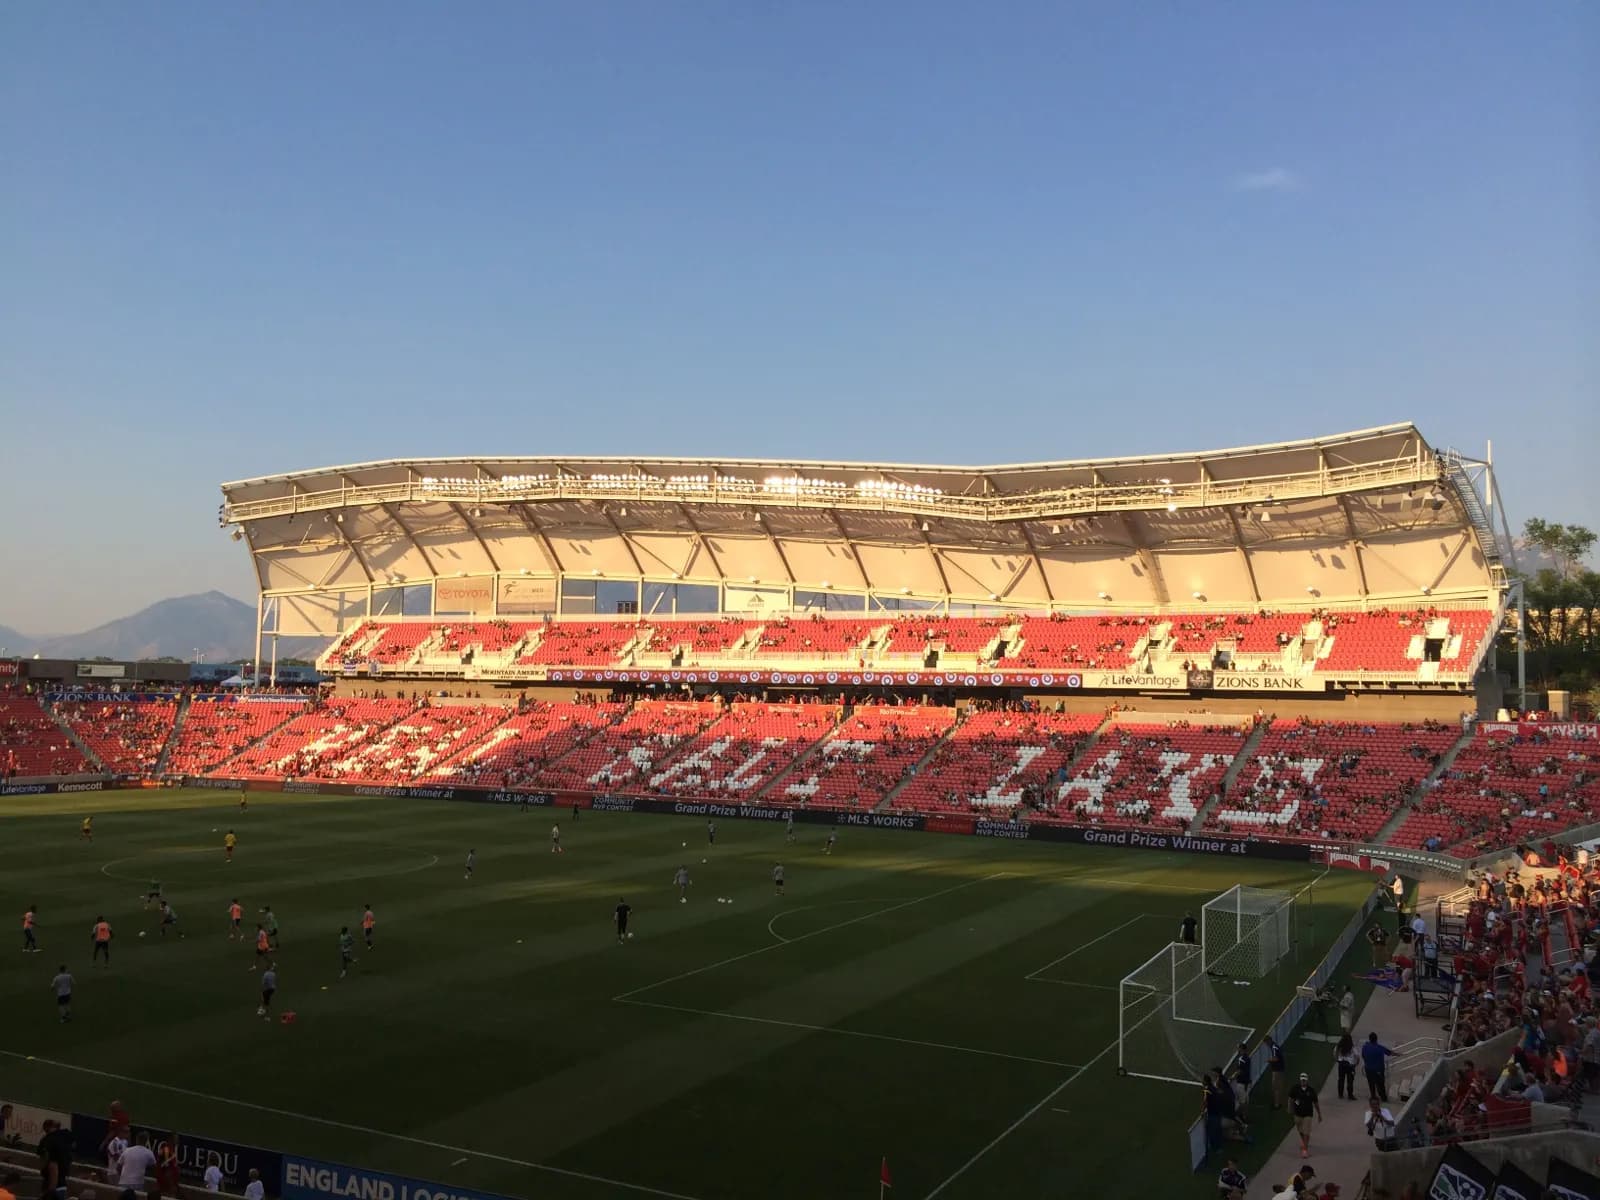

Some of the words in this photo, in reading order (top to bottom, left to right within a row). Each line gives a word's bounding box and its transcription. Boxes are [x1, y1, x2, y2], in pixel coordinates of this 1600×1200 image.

[453, 589, 489, 599] TOYOTA
[1112, 674, 1180, 688] LifeVantage
[1216, 677, 1259, 688] ZIONS
[1264, 677, 1304, 689] BANK
[57, 782, 103, 792] Kennecott
[354, 785, 381, 795] Grand
[384, 787, 407, 796] Prize
[410, 787, 442, 798] Winner
[444, 790, 454, 798] at
[494, 793, 511, 801] MLS
[675, 803, 706, 814] Grand
[709, 805, 736, 816] Prize
[740, 807, 779, 818] Winner
[782, 810, 793, 819] at
[848, 815, 870, 824] MLS
[873, 817, 915, 828] WORKS
[977, 822, 1030, 831] COMMUNITY
[1084, 830, 1126, 844] Grand
[1130, 834, 1167, 847] Prize
[1172, 837, 1226, 851] Winner
[1231, 842, 1247, 853] at
[285, 1163, 395, 1200] ENGLAND
